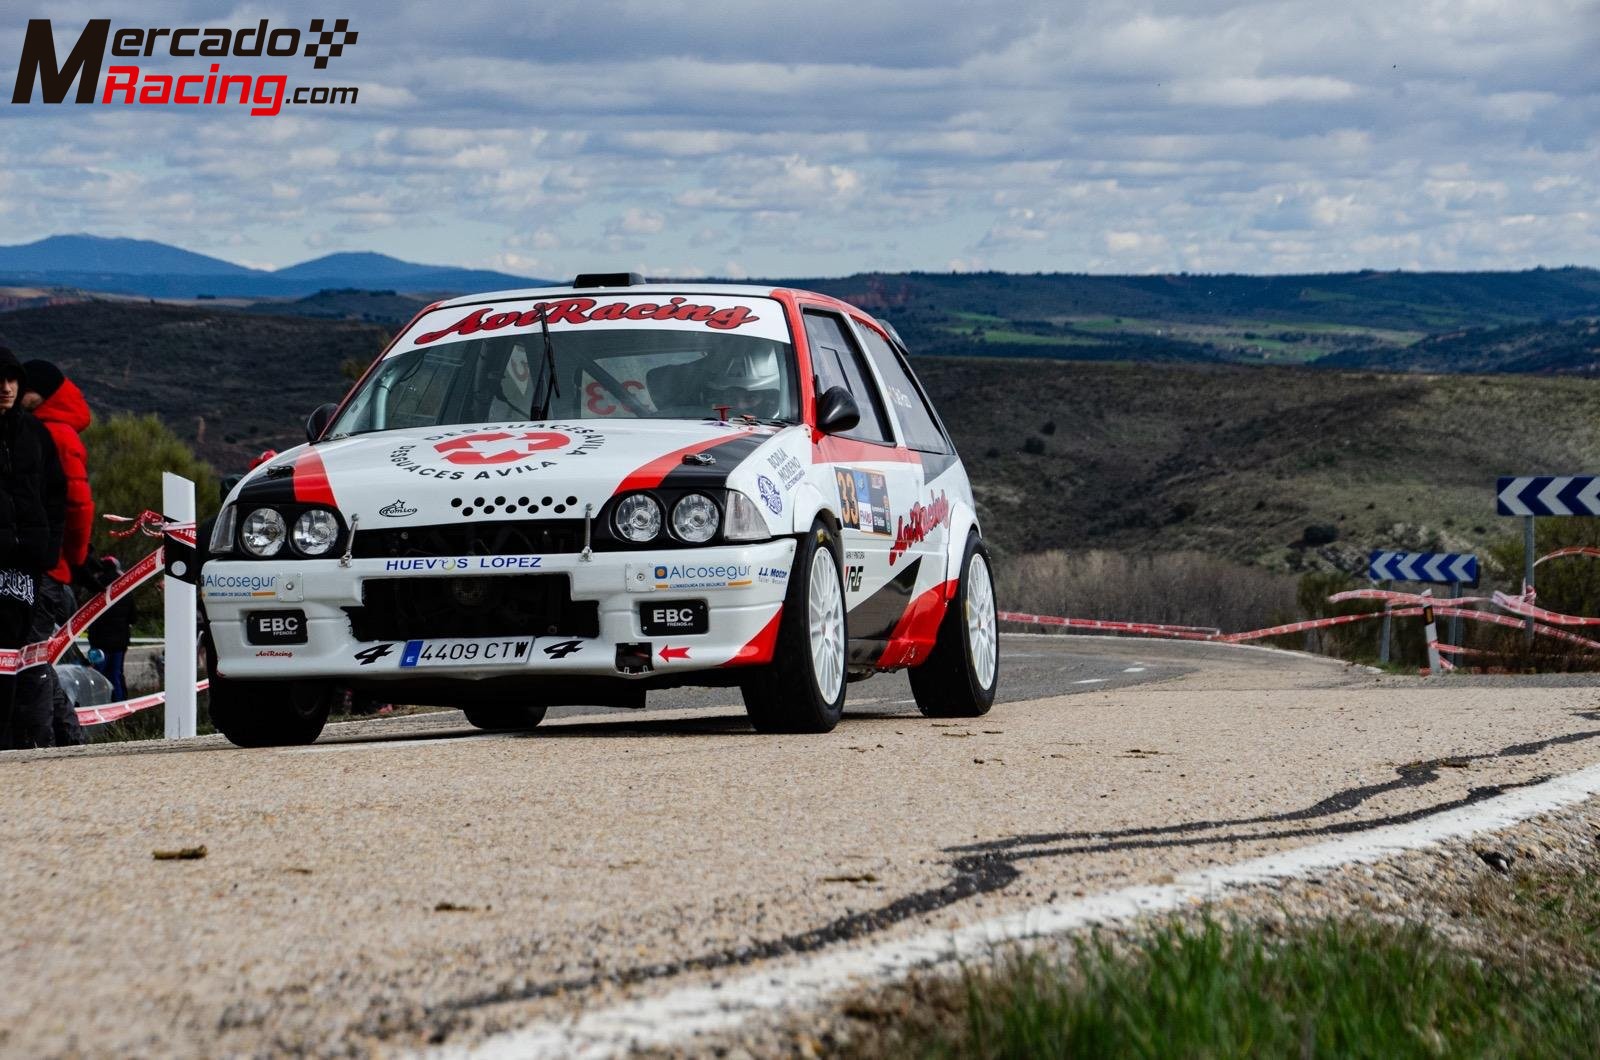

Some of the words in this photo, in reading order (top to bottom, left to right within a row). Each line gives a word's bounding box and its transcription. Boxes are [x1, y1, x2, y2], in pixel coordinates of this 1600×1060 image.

[390, 445, 465, 480] DESGUACES
[474, 461, 558, 480] AVILA
[837, 471, 859, 525] 33
[480, 556, 542, 568] LOPEZ
[669, 564, 752, 580] Alcosegur
[205, 573, 276, 591] Alcosegur
[653, 608, 694, 623] EBC
[259, 617, 299, 632] EBC
[420, 643, 478, 661] 4409
[484, 641, 529, 660] CTW
